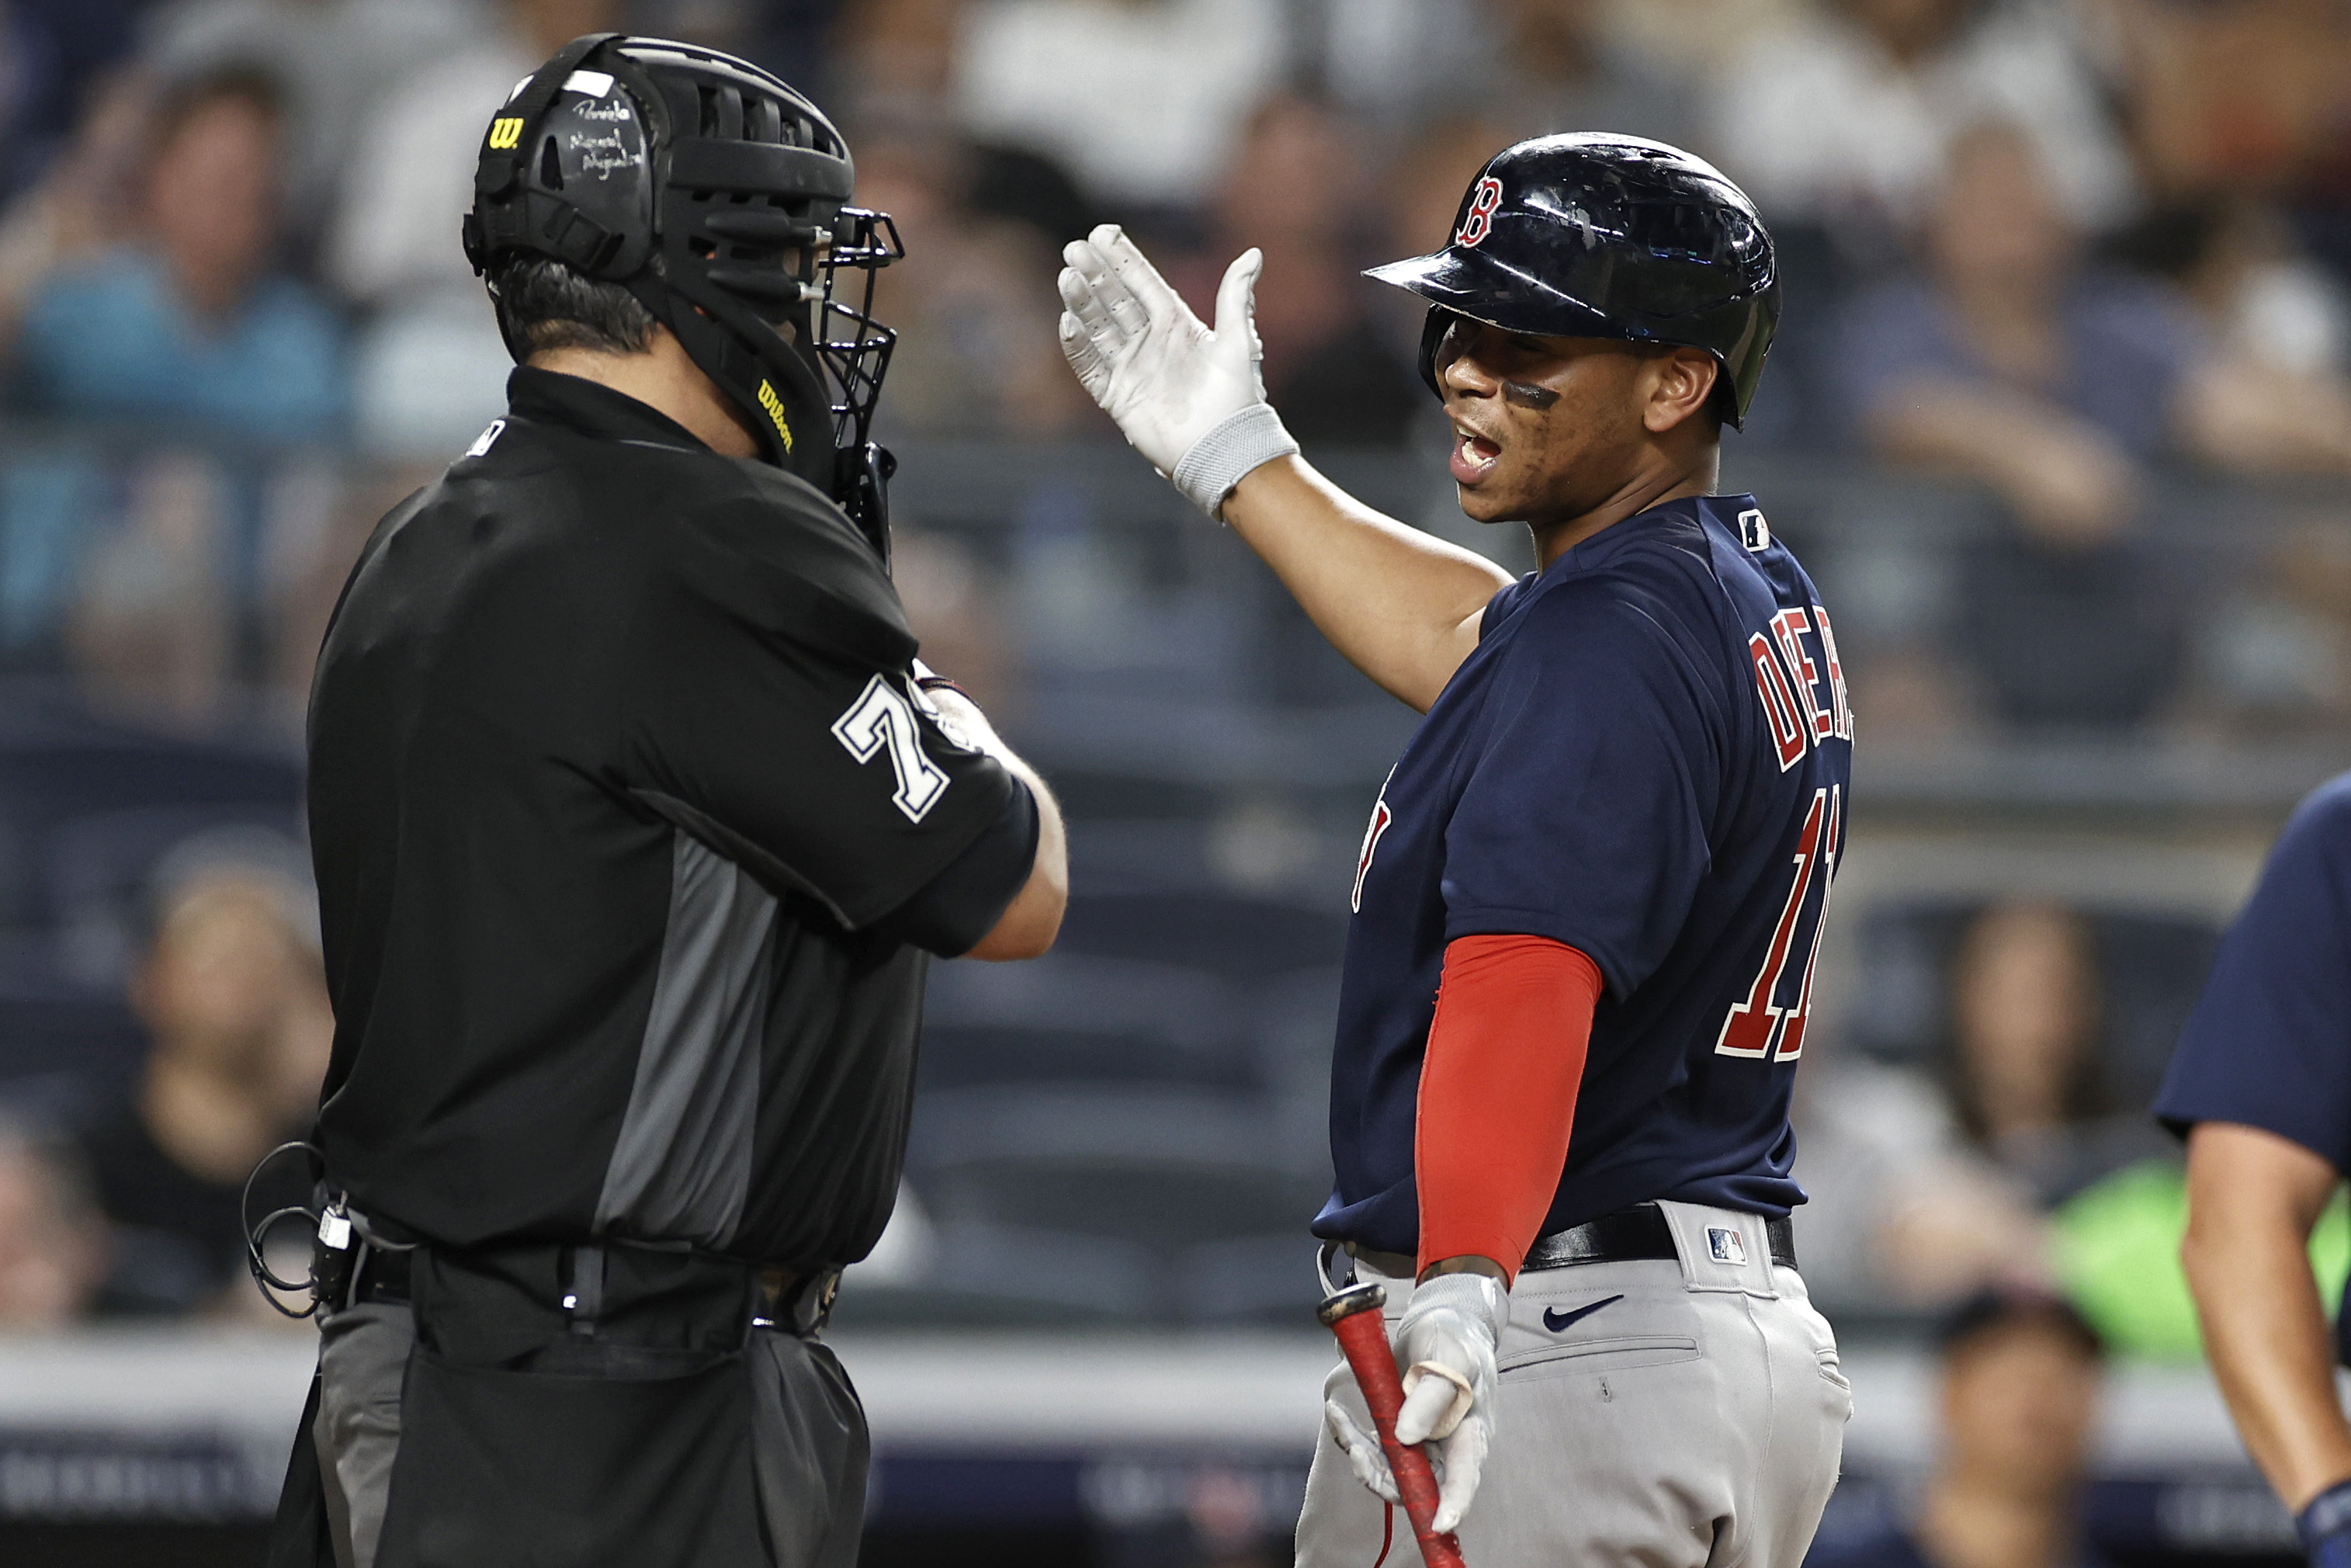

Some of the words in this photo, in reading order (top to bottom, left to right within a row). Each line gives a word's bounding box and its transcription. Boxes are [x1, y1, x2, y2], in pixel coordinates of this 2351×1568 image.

[1455, 175, 1503, 248] B
[758, 378, 793, 455] Wilson
[830, 671, 972, 825] 7
[1714, 783, 1840, 1063] 11
